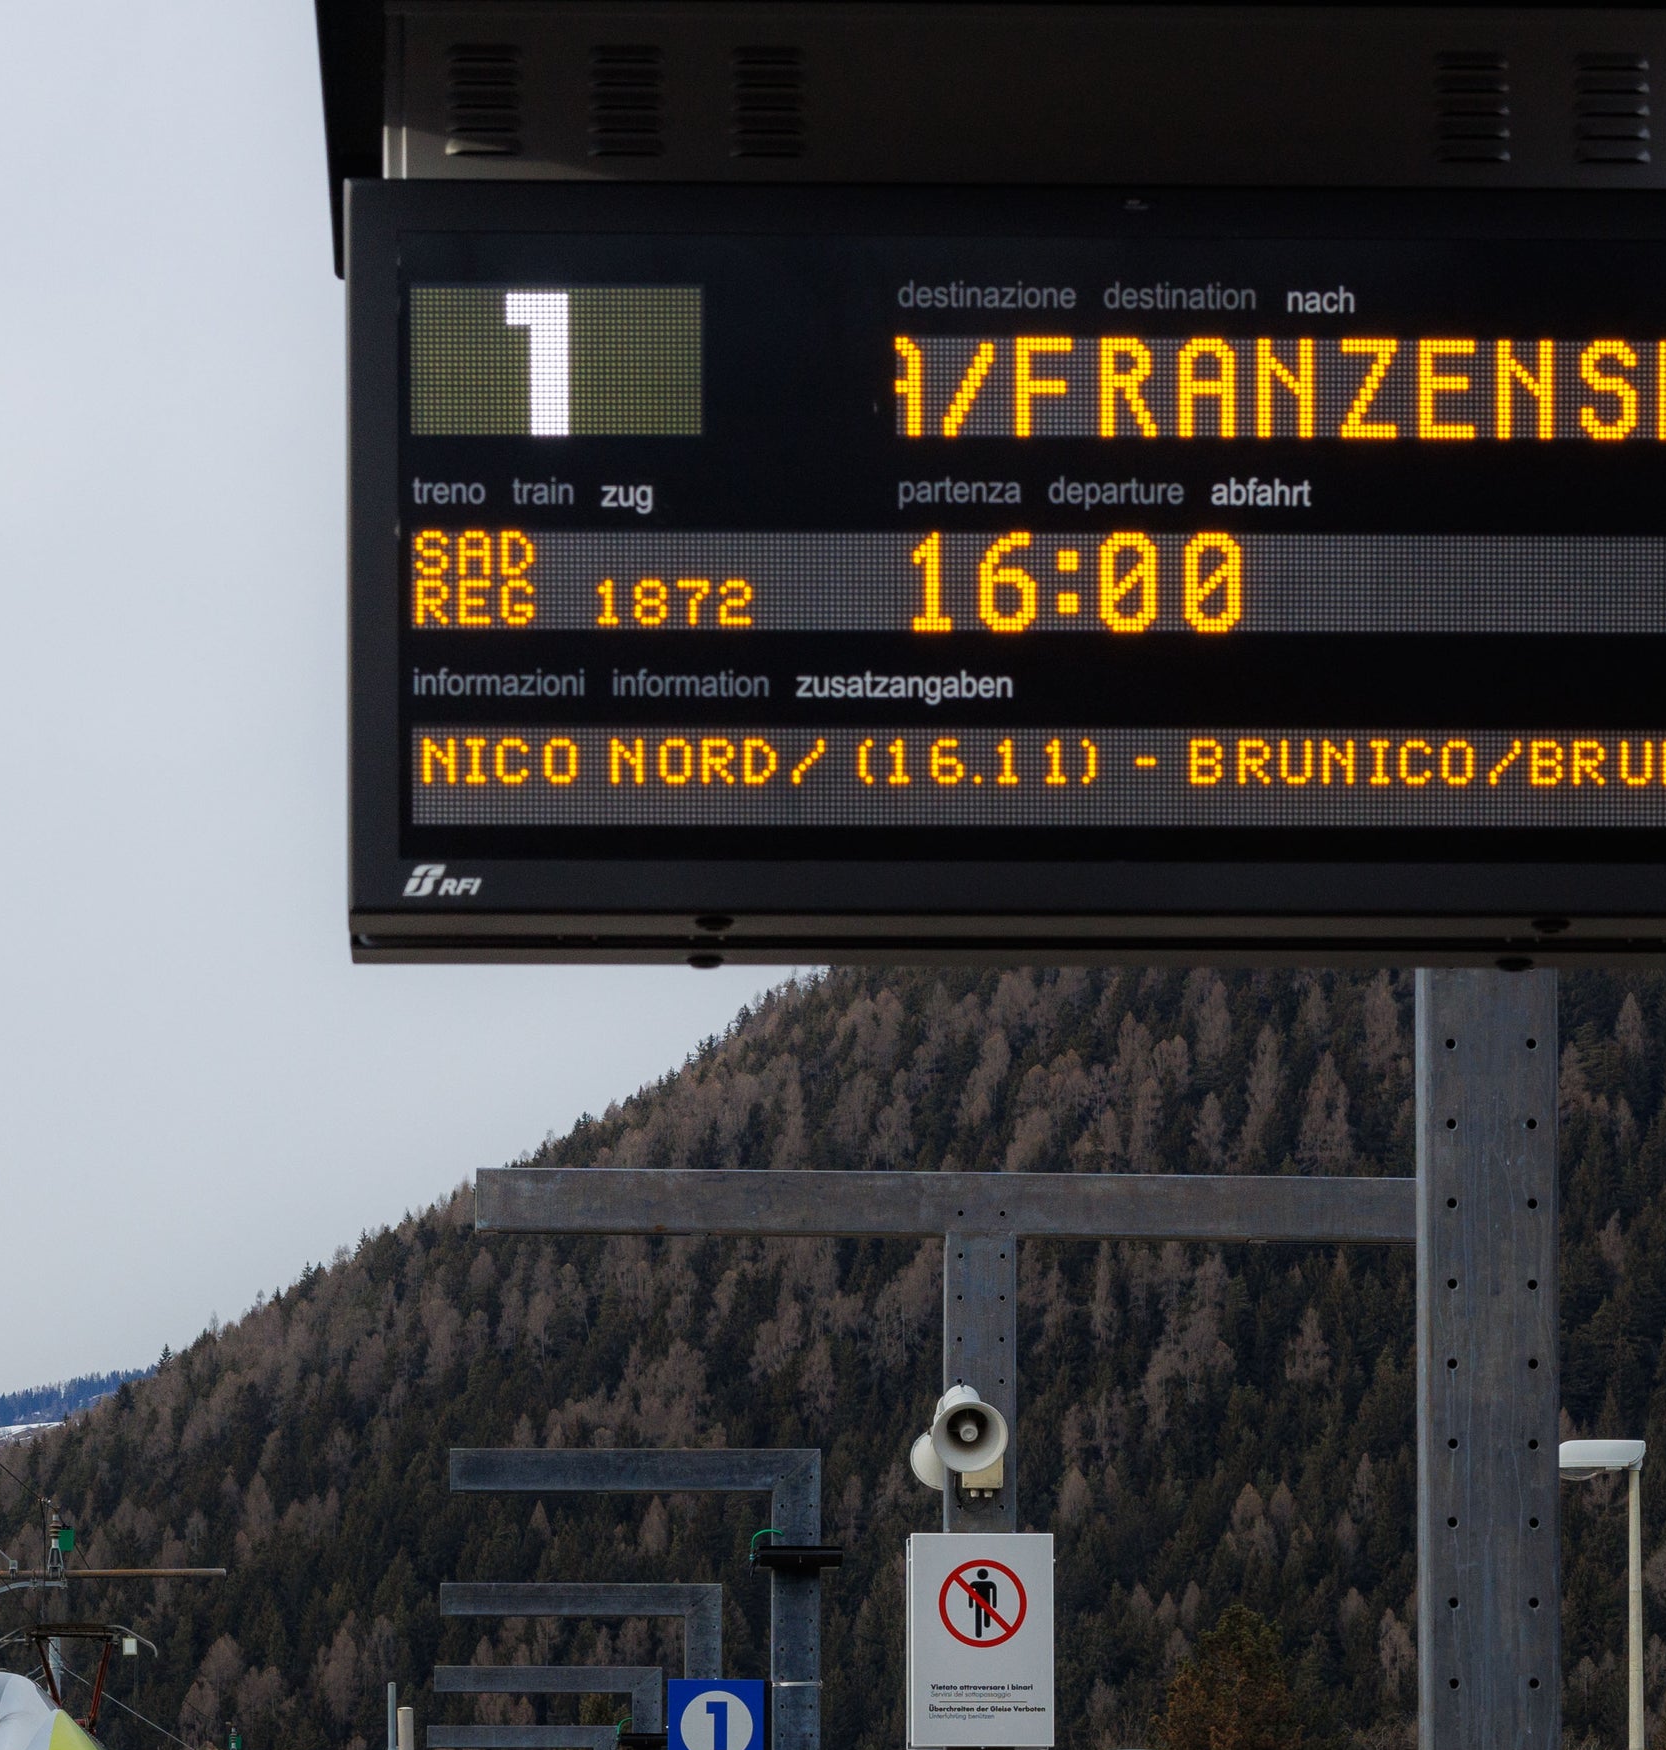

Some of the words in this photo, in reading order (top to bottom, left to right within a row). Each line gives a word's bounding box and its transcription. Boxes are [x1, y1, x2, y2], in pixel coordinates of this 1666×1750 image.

[897, 280, 1077, 309] destinazione
[1103, 281, 1256, 311] destination
[1287, 285, 1355, 314] nach
[505, 293, 571, 437] 1
[412, 477, 487, 505] treno
[511, 477, 575, 506] train
[600, 484, 654, 514] zug
[897, 477, 1022, 511] partenza
[1047, 476, 1185, 512] departure
[1210, 477, 1312, 509] abfahrt
[414, 530, 536, 576] SAD
[414, 579, 536, 627] REG
[596, 579, 754, 627] 1872
[910, 530, 1243, 634] 16:00
[412, 666, 586, 698] informazioni
[612, 668, 771, 698] information
[795, 669, 1014, 706] zusatzangaben
[421, 737, 579, 786] NICO
[608, 737, 826, 786] NORD/
[857, 738, 1099, 787] (16.11)
[438, 878, 482, 896] RFI
